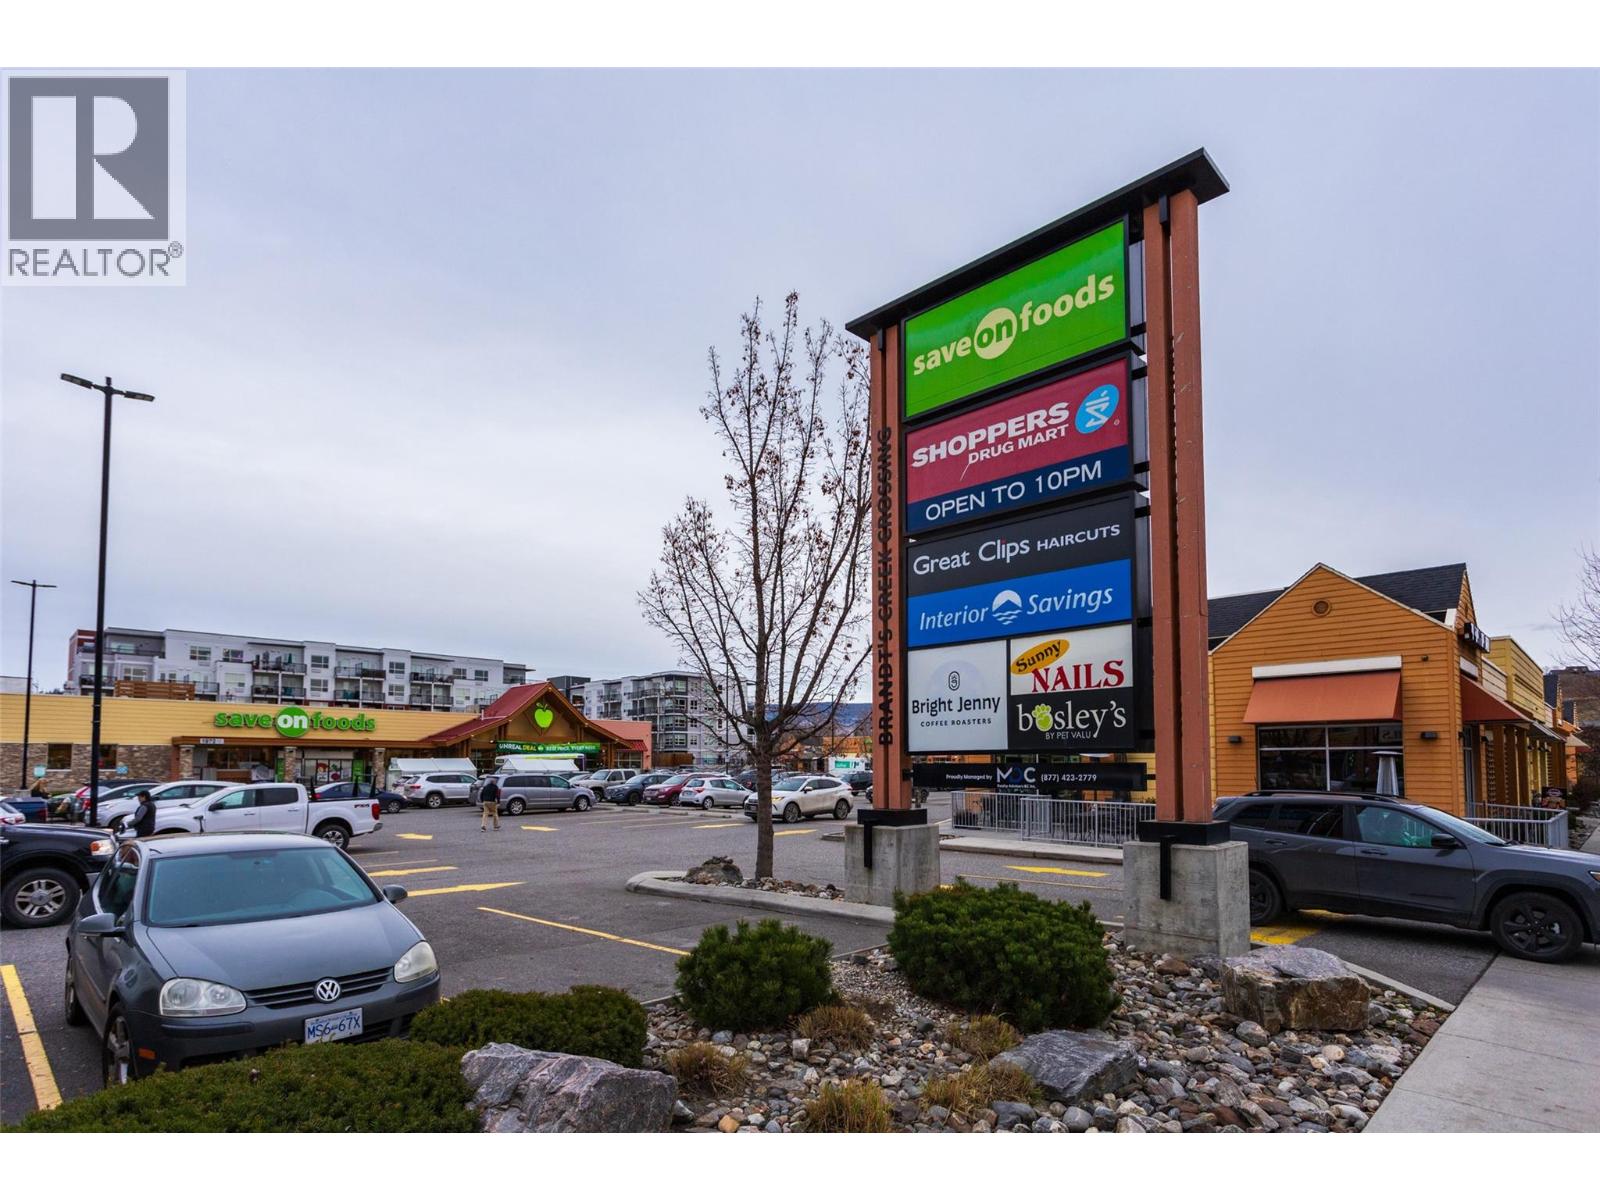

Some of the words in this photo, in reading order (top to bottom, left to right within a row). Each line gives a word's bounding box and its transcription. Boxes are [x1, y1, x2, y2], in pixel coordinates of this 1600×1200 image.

[913, 336, 972, 376] save
[976, 317, 1015, 347] on
[1019, 273, 1115, 332] foods
[911, 401, 1070, 468] SHOPPERS
[968, 440, 1014, 465] DRUG
[1017, 423, 1070, 450] MART
[925, 490, 986, 521] OPEN
[991, 480, 1026, 504] TO
[1035, 460, 1103, 494] 10PM
[913, 550, 971, 576] Great
[978, 538, 1031, 564] Clips
[1036, 524, 1121, 552] HAIRCUTS
[878, 548, 893, 622] CREEK
[920, 605, 990, 631] Interior
[1026, 587, 1114, 615] Savings
[1015, 639, 1063, 673] Sunny
[878, 629, 894, 745] BRANDT'S
[1031, 659, 1125, 694] NAILS
[215, 712, 273, 727] save
[277, 714, 308, 729] on
[312, 711, 376, 731] foods
[912, 697, 954, 717] Bright
[957, 695, 1001, 714] Jenny
[919, 719, 949, 728] COFFEE
[951, 717, 992, 726] ROASTERS
[1016, 700, 1127, 739] bosley's
[1045, 732, 1055, 740] BY
[1056, 731, 1070, 740] PET
[1071, 731, 1092, 739] VALU
[1041, 774, 1059, 782] (877)
[1061, 774, 1097, 782] 423-2779
